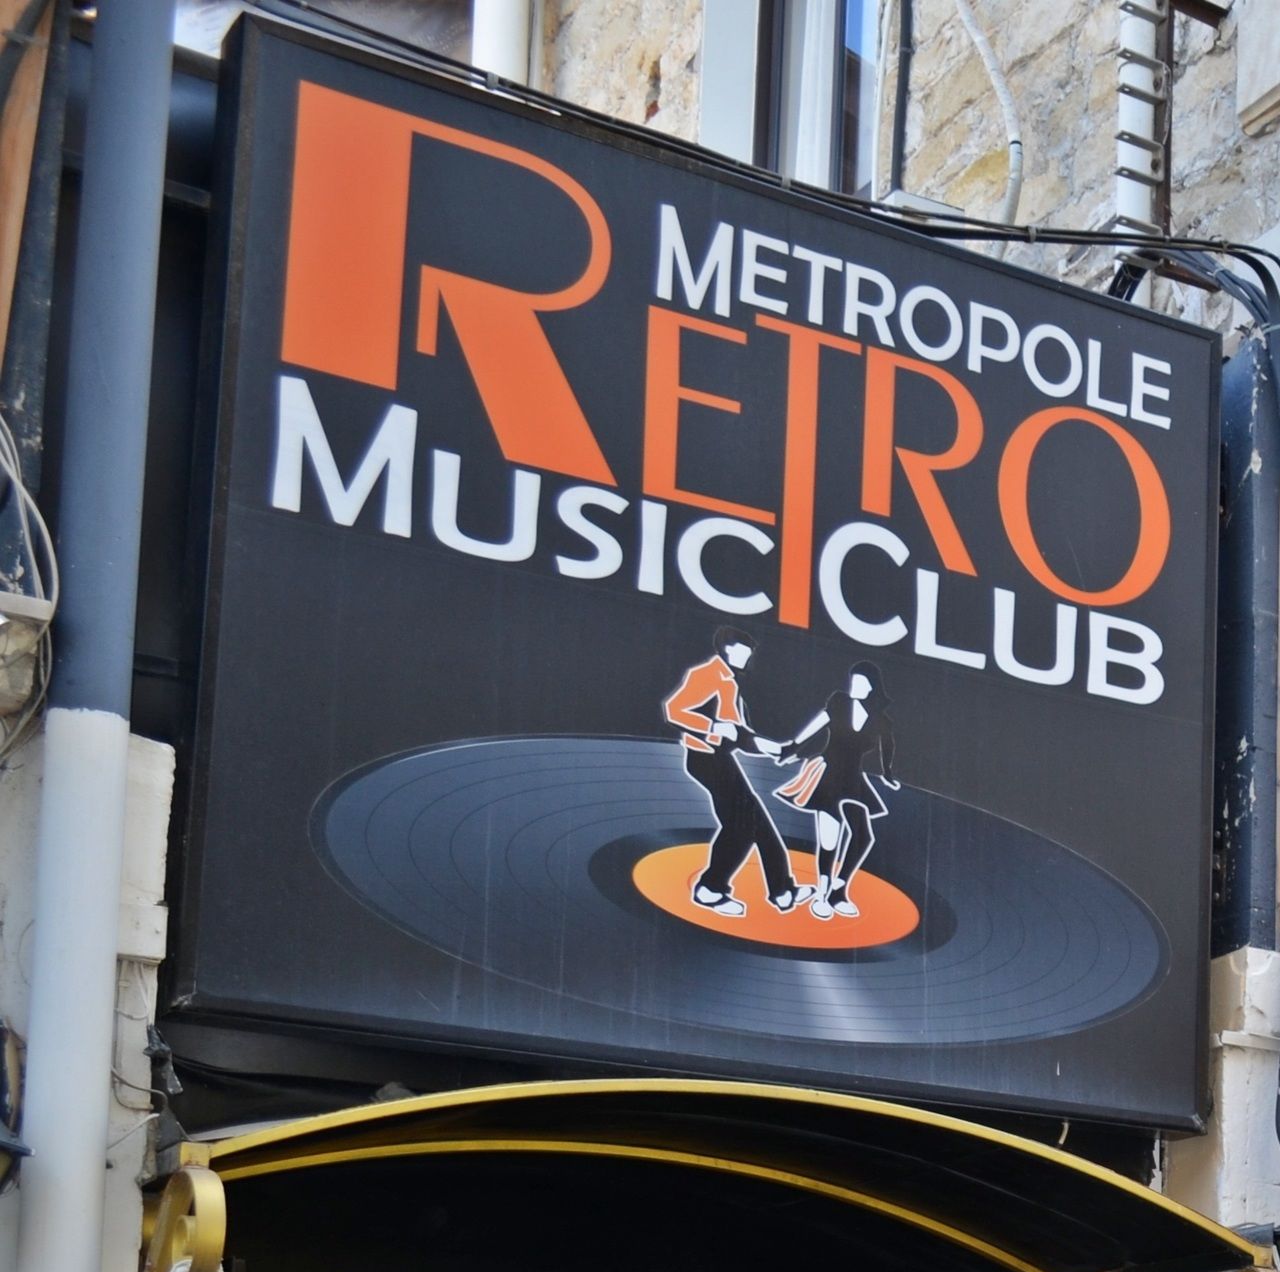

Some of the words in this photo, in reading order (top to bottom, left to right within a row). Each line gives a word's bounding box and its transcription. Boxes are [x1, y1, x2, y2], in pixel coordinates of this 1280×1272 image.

[280, 80, 1171, 629] RETRO
[657, 204, 1171, 430] METROPOLE
[271, 375, 774, 616] MUSIC
[818, 520, 1166, 705] CLUB
